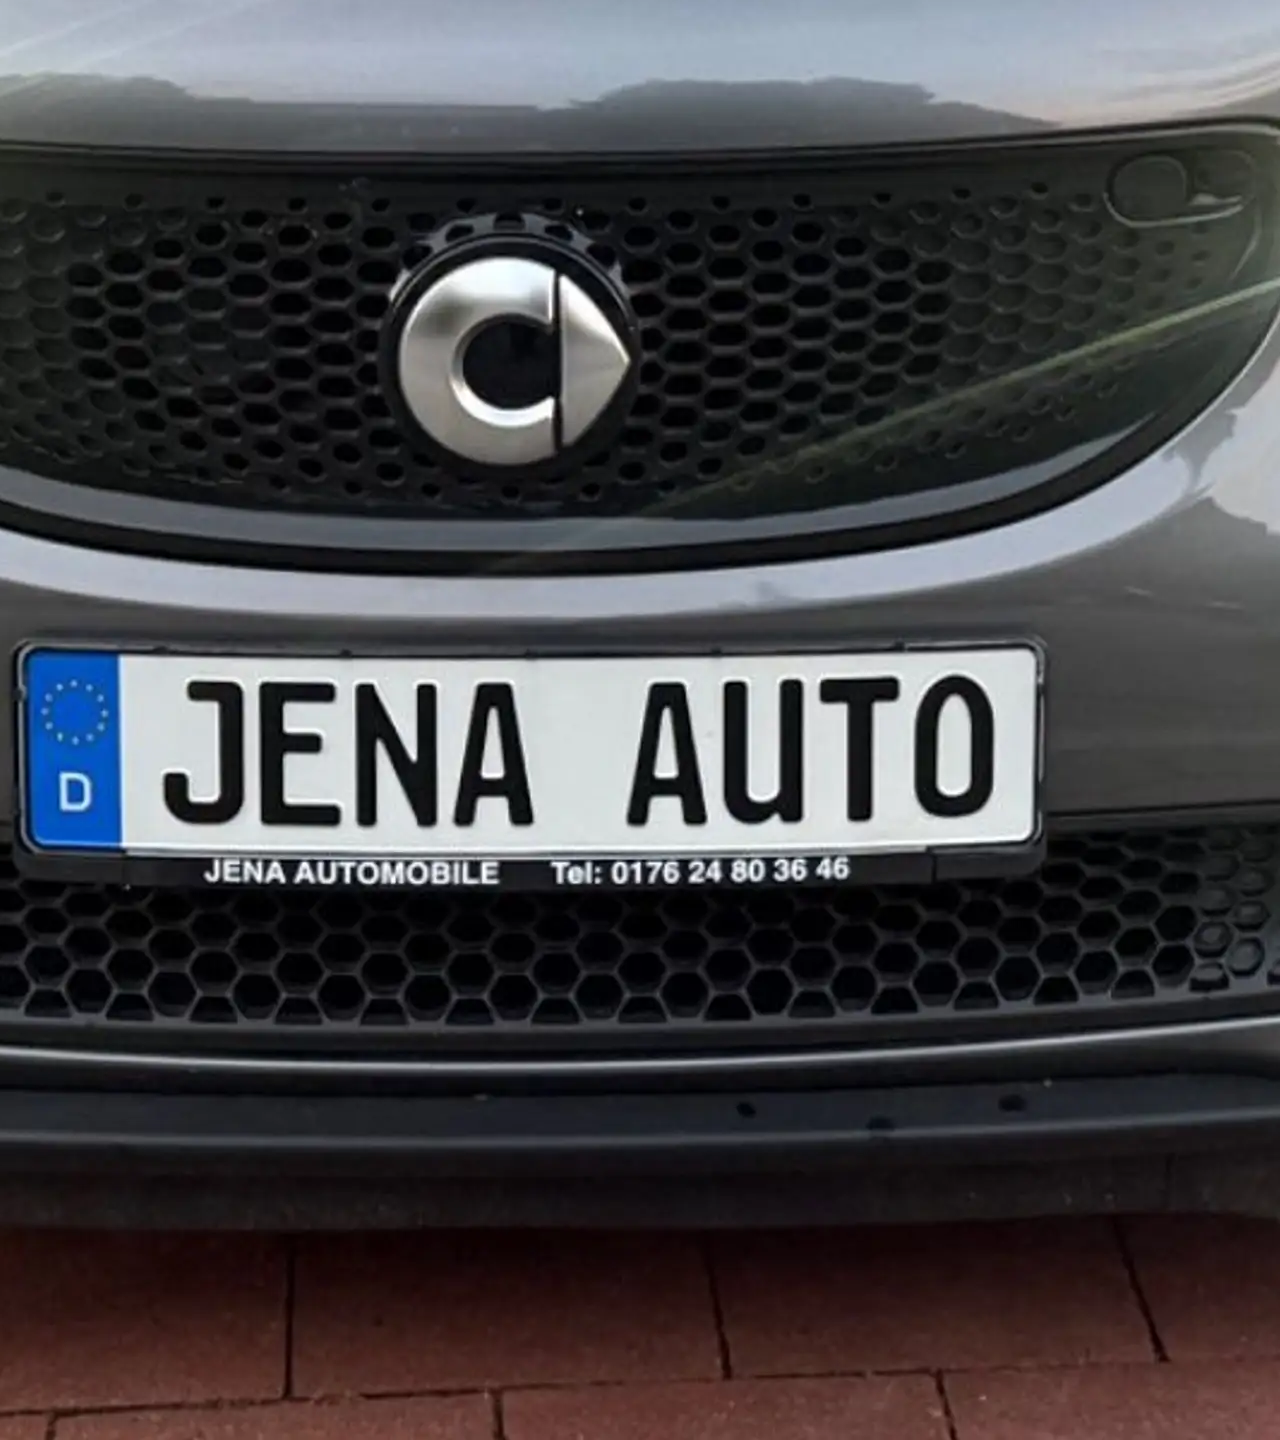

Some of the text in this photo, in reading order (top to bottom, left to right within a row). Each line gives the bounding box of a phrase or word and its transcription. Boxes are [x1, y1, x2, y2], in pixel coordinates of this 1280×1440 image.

[162, 673, 995, 827] JENA AUTO
[58, 771, 93, 813] D
[203, 855, 850, 886] JENA AUTOMOBILE Tel: 0176 24 80 36 46
